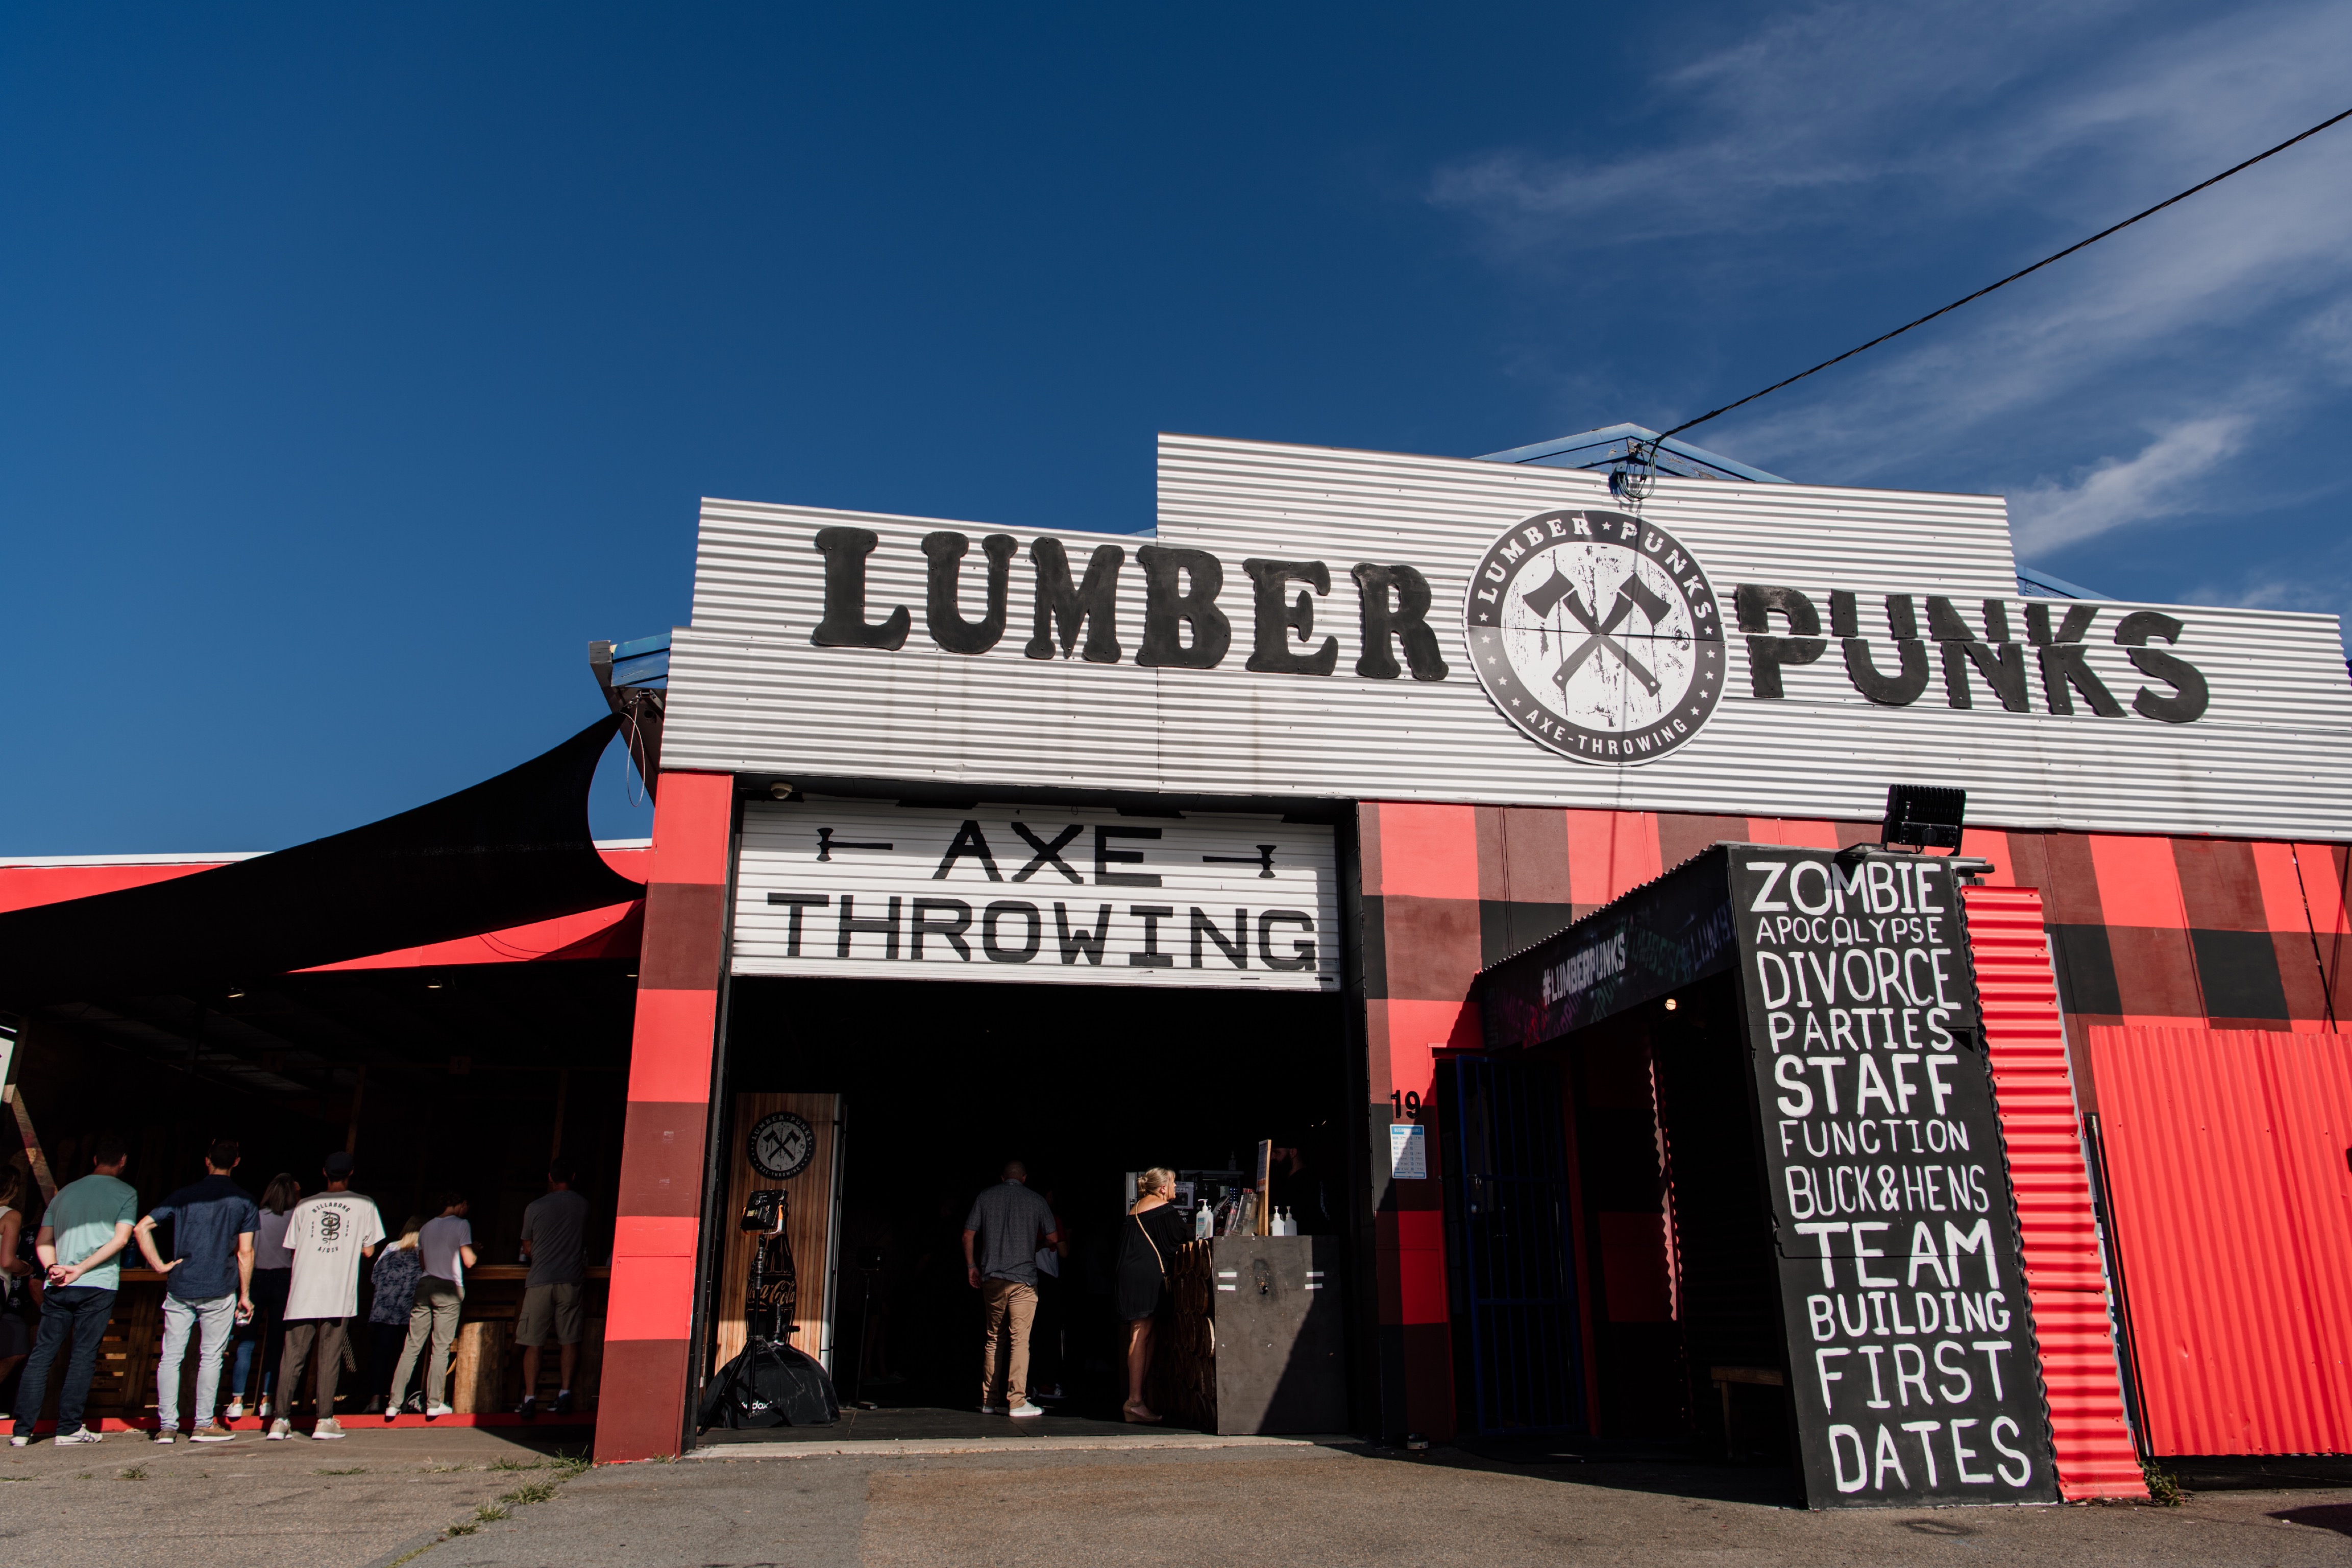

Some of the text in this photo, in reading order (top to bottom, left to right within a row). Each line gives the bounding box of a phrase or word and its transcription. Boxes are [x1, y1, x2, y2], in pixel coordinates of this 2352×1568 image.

[1478, 517, 1712, 619] LUMBER PUNKS
[812, 526, 2210, 723] LUMBER PUNKS
[1526, 709, 1687, 755] AXE-THROWING
[932, 819, 1162, 888] AXE
[1746, 861, 1944, 915] ZOMBIE
[767, 892, 1317, 971] THROWING
[1542, 933, 1626, 1006] #LUMBERPUNKS
[1756, 948, 1962, 1010] DIVORCE
[1768, 1008, 1954, 1053] PARTIES
[1391, 1090, 1420, 1118] 19
[1775, 1054, 1958, 1118] STAFF
[751, 1115, 812, 1141] LUMBER PUNKS
[1779, 1119, 1970, 1157] FUNCTION
[759, 1166, 800, 1177] AXE-THROWING
[1786, 1165, 1990, 1219] BUCK&HENS
[312, 1202, 351, 1213] BILLABONG
[1795, 1218, 2000, 1289] TEAM
[746, 1280, 796, 1305] Coa-Cola
[1807, 1291, 2011, 1341] BUILDING
[741, 1400, 769, 1409] dox
[1816, 1340, 2012, 1415] FIRST
[1829, 1416, 2031, 1492] DATES
